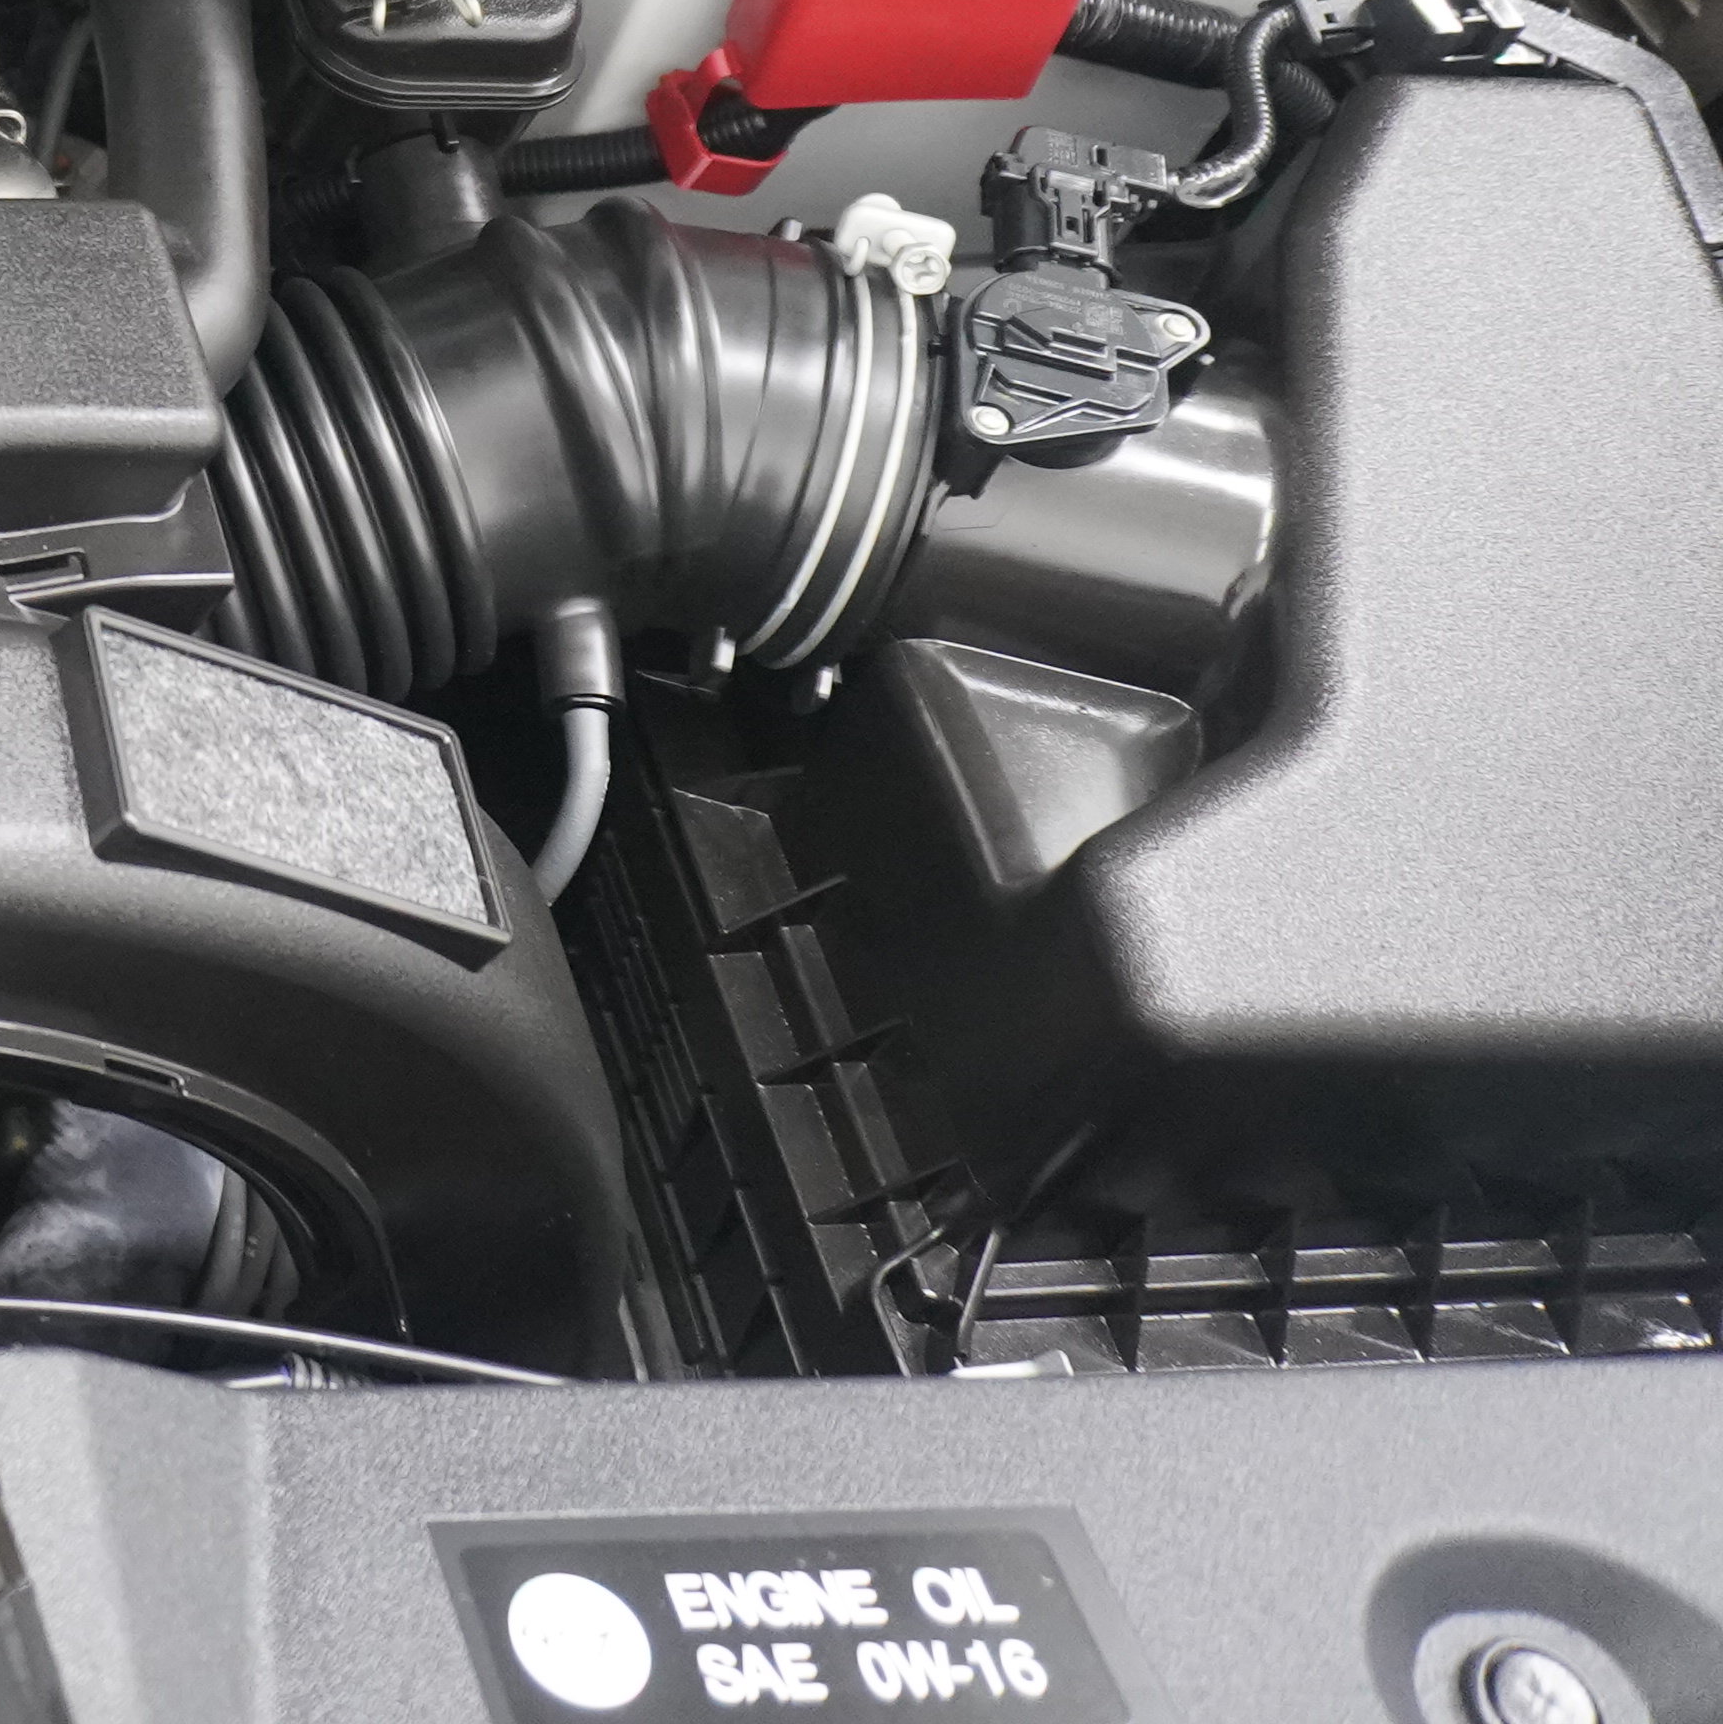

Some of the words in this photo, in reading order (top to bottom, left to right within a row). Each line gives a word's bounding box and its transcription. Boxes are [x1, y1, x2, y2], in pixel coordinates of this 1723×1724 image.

[663, 1568, 889, 1630] ENGINE
[911, 1566, 1021, 1626] OIL
[695, 1641, 830, 1705] SAE
[856, 1637, 1049, 1703] 0W-16
